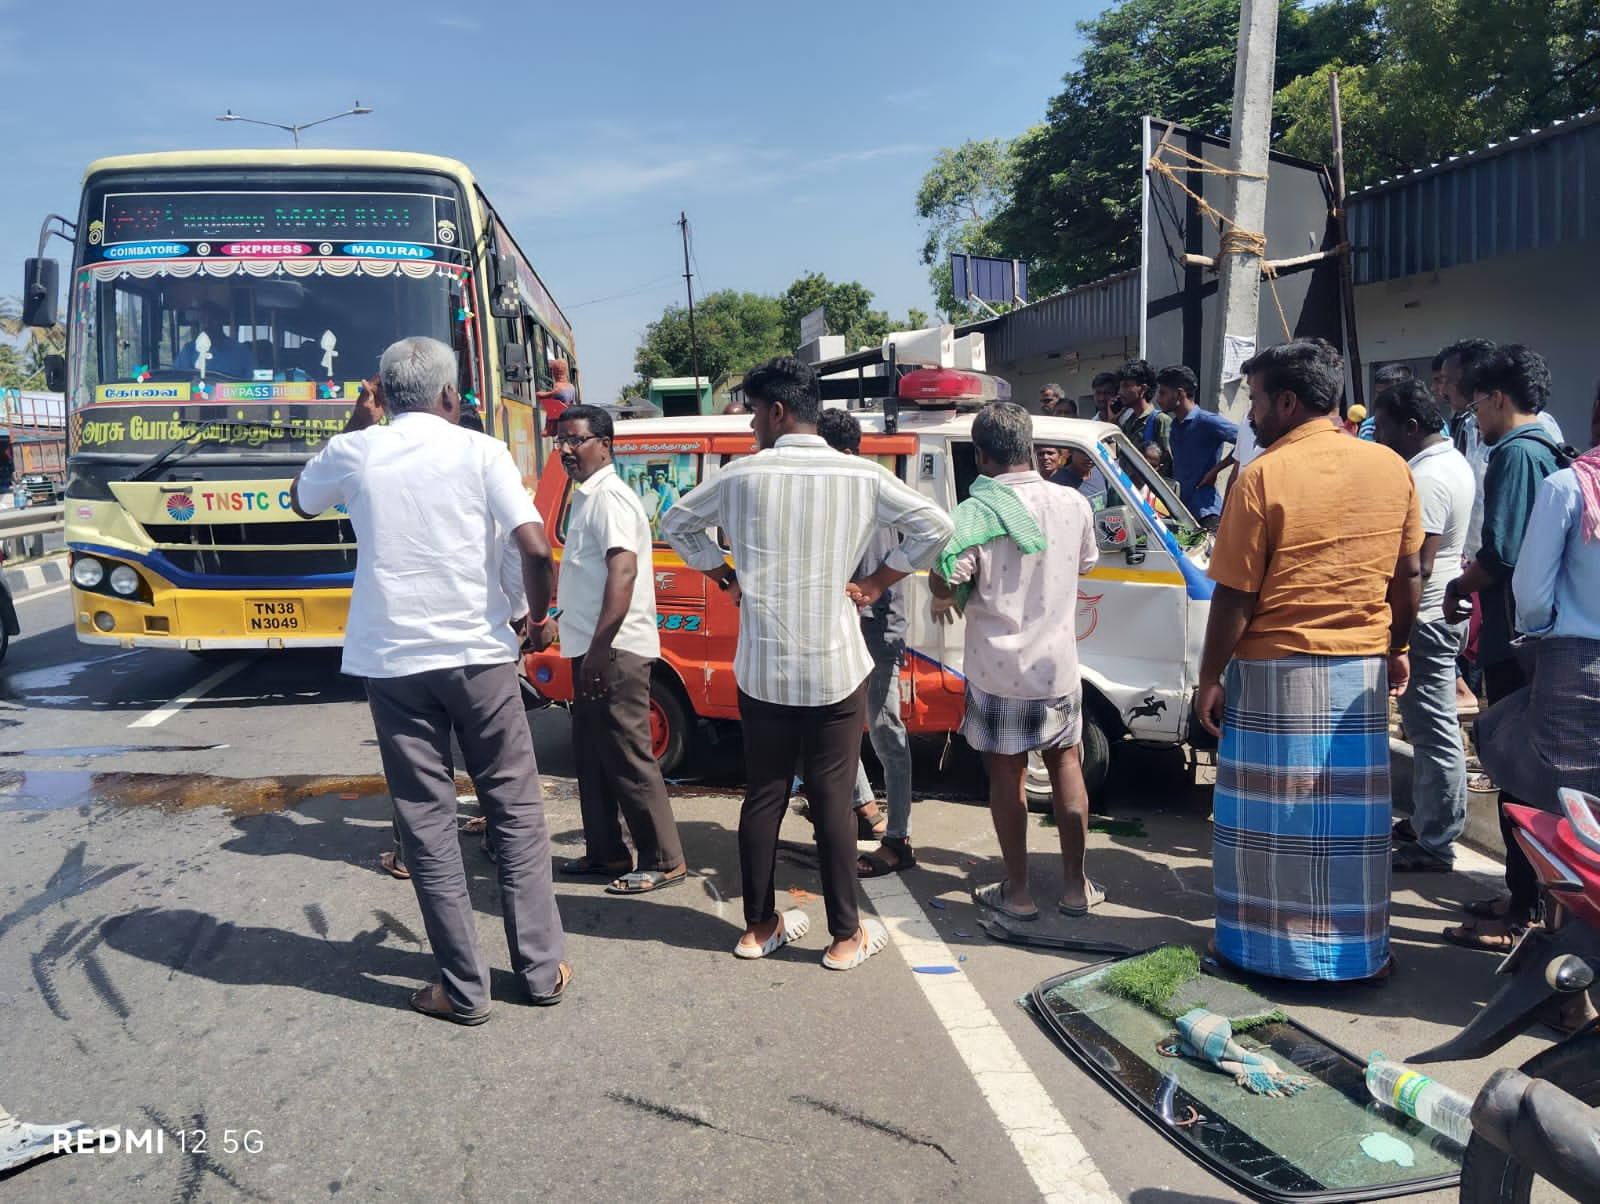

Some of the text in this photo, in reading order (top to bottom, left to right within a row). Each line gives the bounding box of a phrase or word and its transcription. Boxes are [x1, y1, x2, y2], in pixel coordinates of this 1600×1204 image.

[110, 245, 181, 257] COIMBATORE
[231, 244, 303, 254] EXPRESS
[351, 245, 424, 257] MADURAI
[223, 386, 269, 398] BYPASS
[82, 420, 126, 446] அரசு
[202, 492, 269, 511] TNSTC
[254, 603, 295, 614] TN 38
[251, 617, 298, 629] N3049
